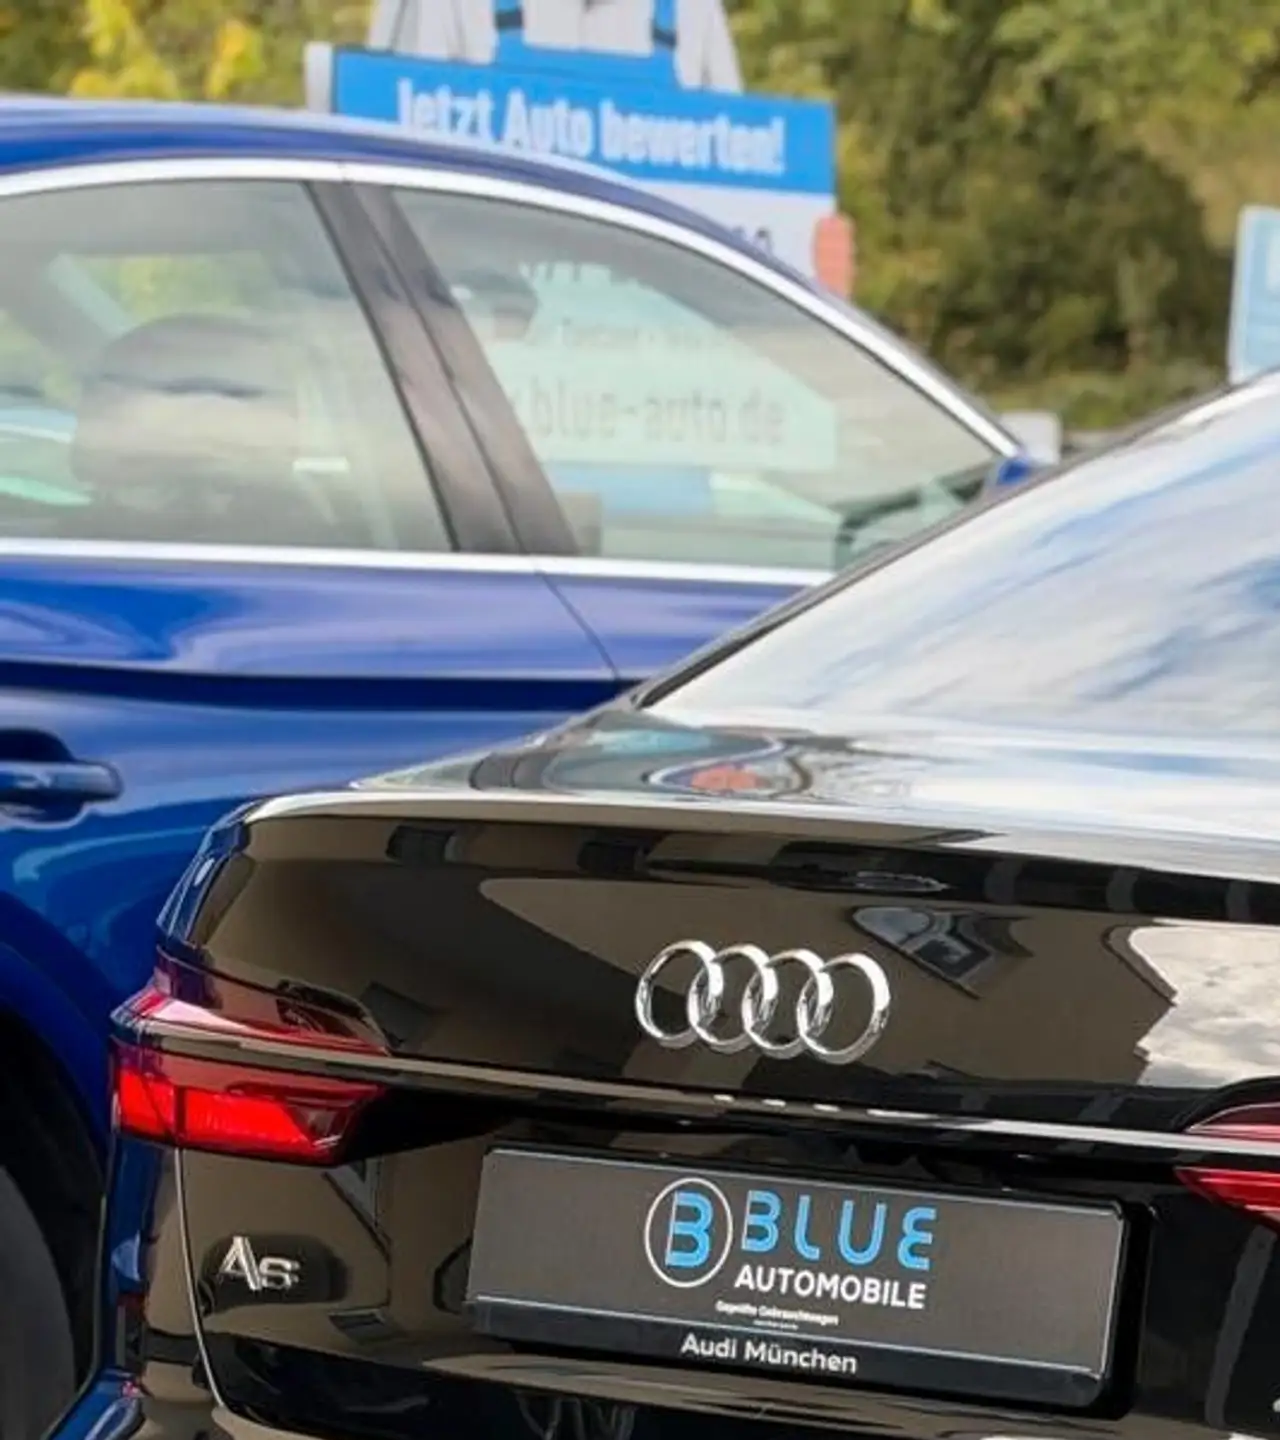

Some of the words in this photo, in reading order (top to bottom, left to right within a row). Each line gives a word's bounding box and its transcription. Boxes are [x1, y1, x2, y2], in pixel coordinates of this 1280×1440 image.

[397, 78, 496, 144] Jetzt
[504, 89, 595, 158] Auto
[602, 100, 786, 175] bewerten!
[740, 1189, 937, 1271] BLUE
[733, 1263, 927, 1310] AUTOMOBILE
[680, 1332, 737, 1360] Audi
[744, 1338, 858, 1375] München
